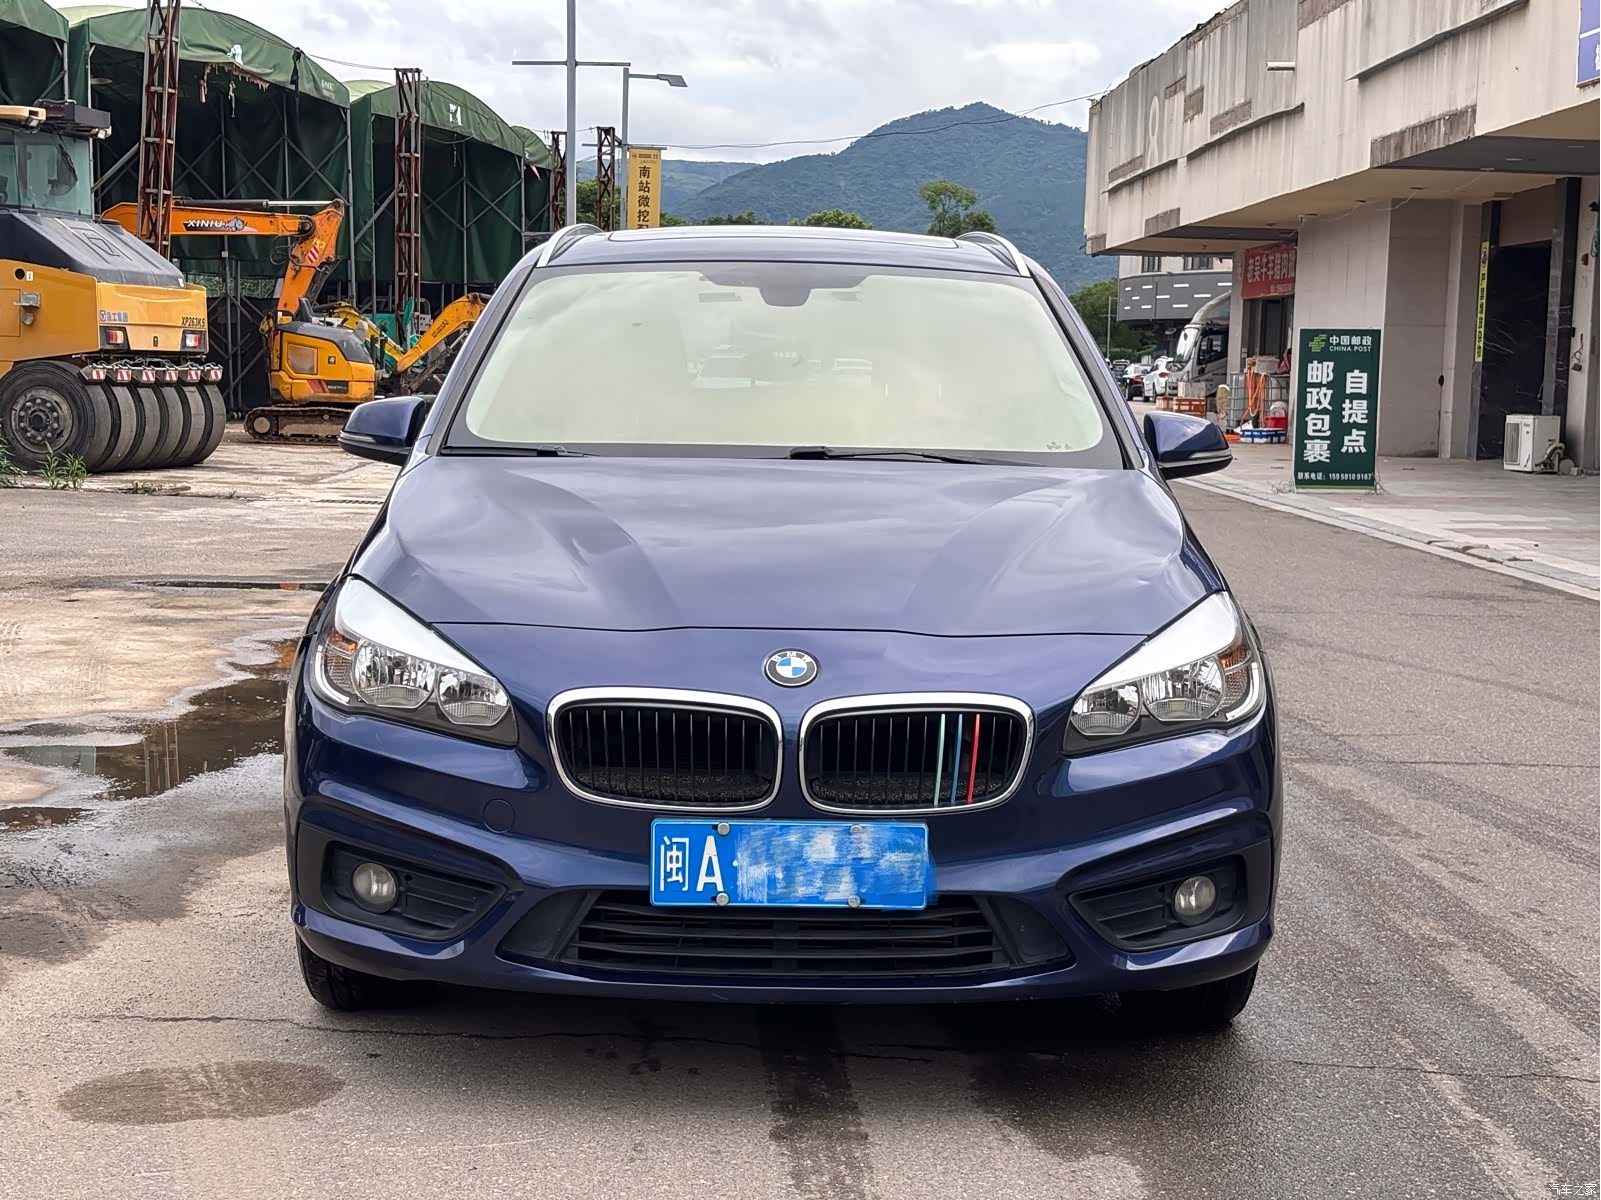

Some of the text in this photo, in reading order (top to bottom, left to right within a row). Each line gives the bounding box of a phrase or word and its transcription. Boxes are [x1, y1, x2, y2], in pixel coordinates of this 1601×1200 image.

[187, 219, 224, 228] XINIU
[637, 165, 651, 229] 南站微挖
[1329, 335, 1372, 346] 中国邮政
[1303, 360, 1334, 464] 邮政包裹
[1340, 369, 1369, 454] 自提点
